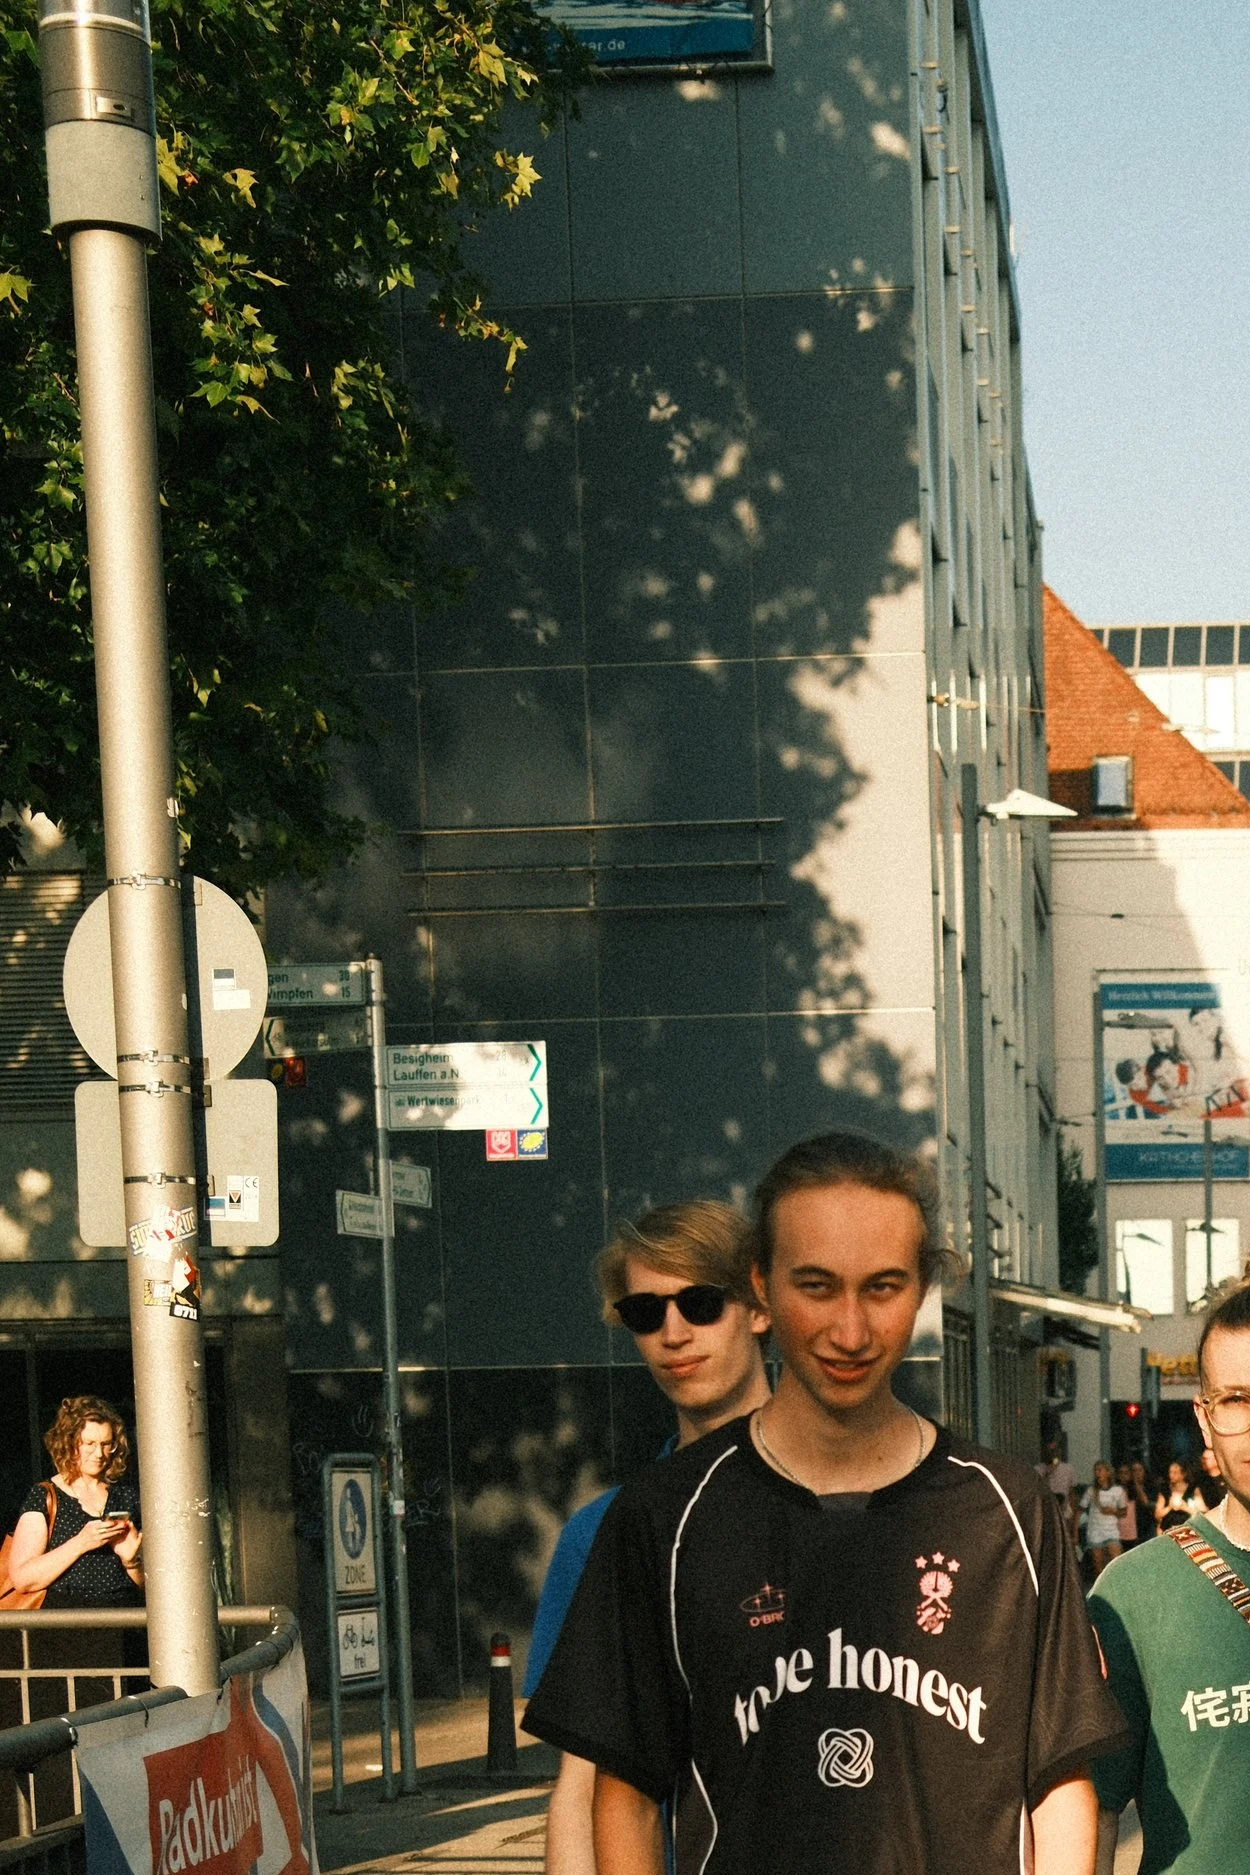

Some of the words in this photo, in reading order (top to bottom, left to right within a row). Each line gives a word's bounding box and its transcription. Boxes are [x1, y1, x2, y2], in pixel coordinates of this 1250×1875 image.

[393, 1068, 436, 1081] Lauffen
[344, 1564, 367, 1585] ZONE
[354, 1653, 367, 1669] frei
[827, 1627, 987, 1745] honest
